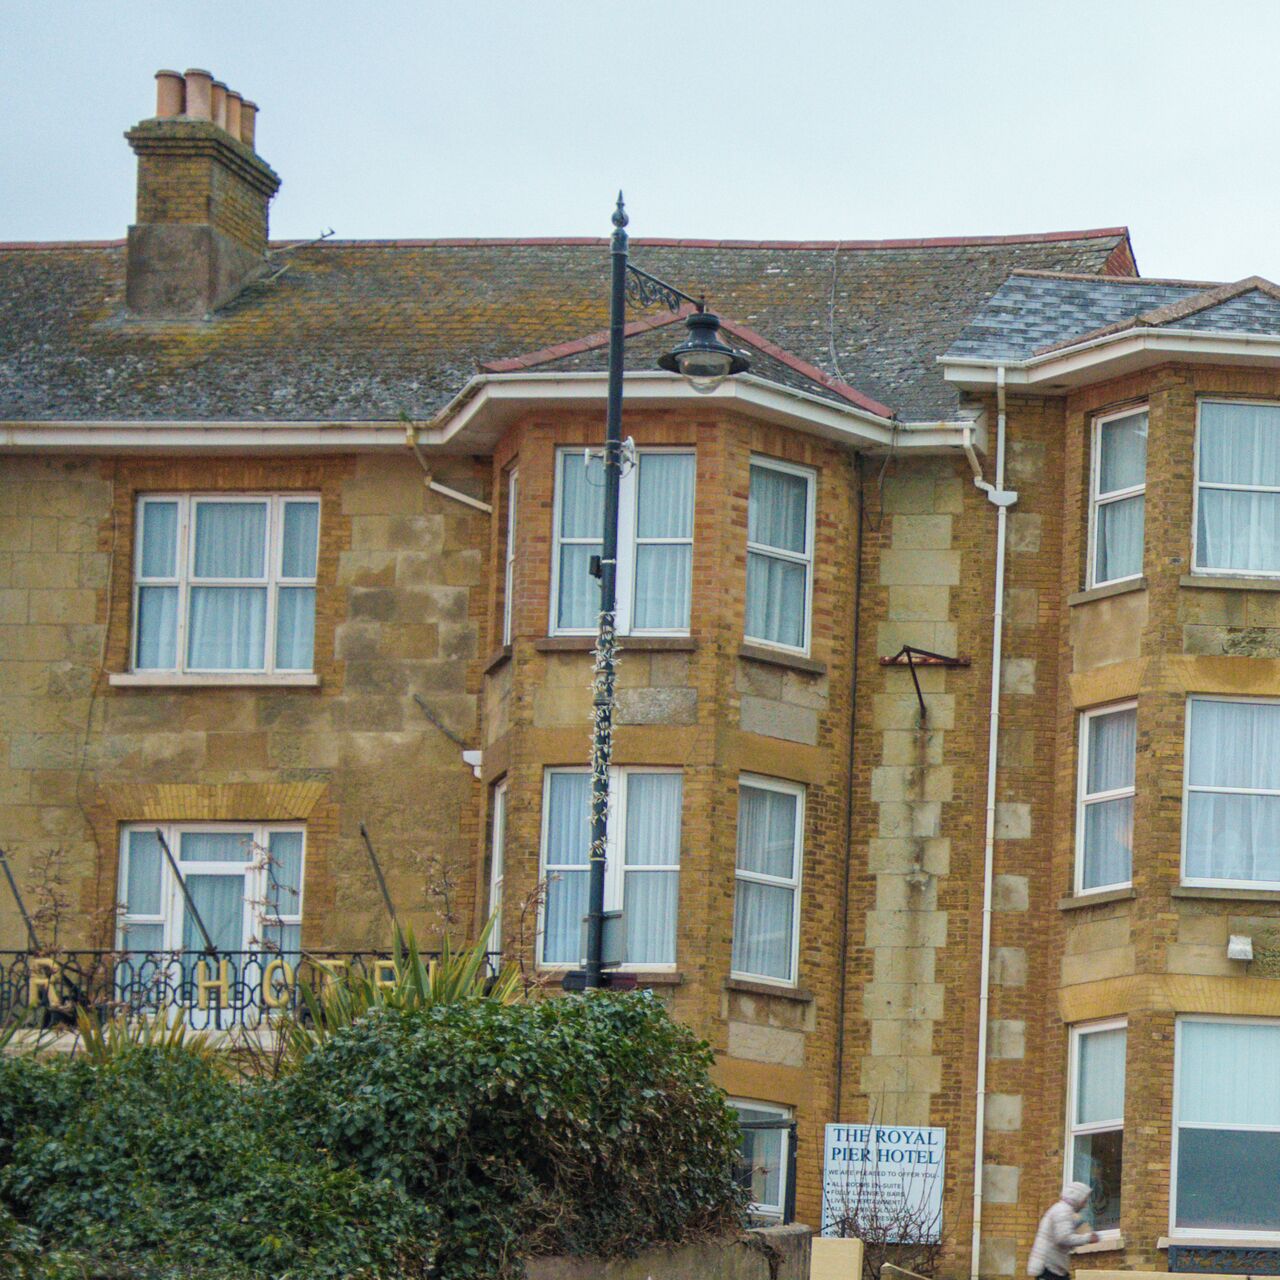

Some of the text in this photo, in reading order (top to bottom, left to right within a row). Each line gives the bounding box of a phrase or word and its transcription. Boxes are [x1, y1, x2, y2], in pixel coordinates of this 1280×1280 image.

[833, 1128, 939, 1146] THE ROYAL
[832, 1147, 939, 1165] PIER HOTEL
